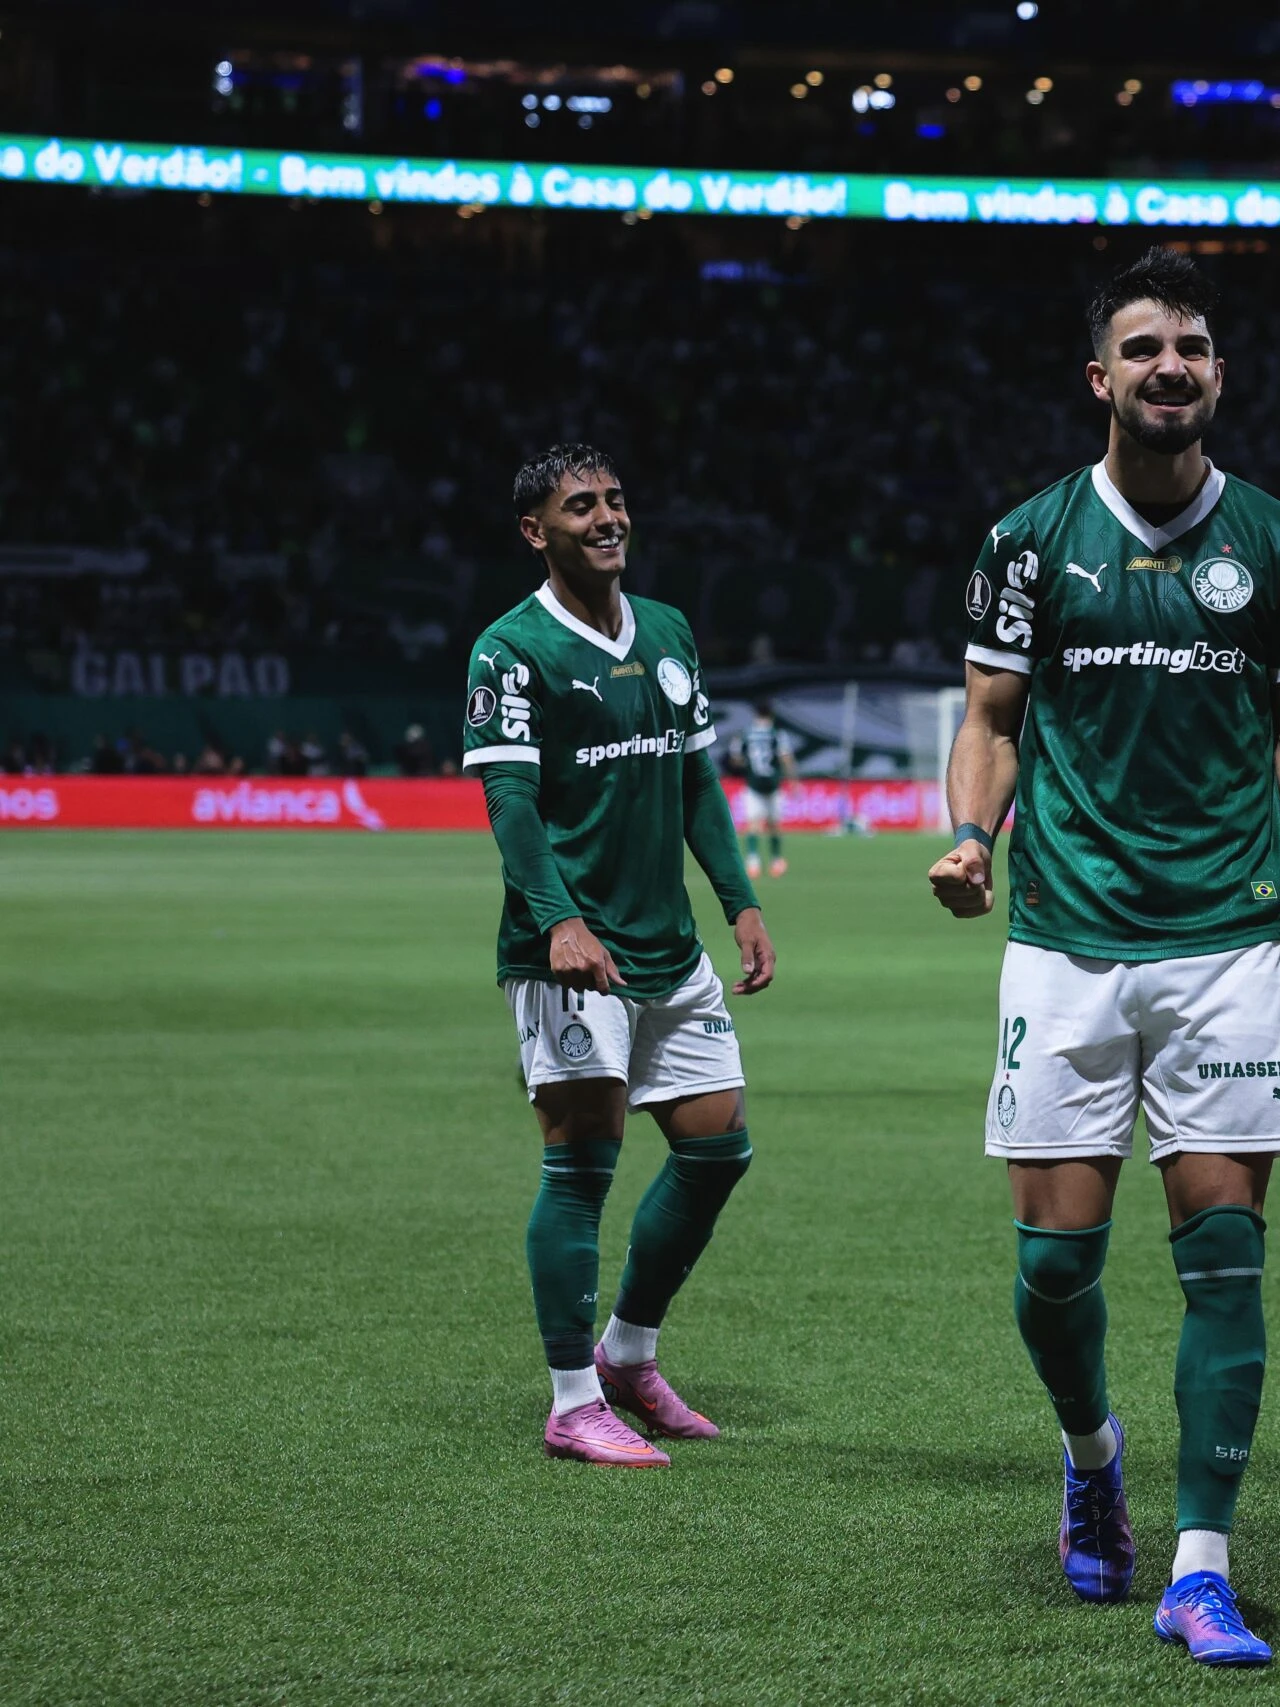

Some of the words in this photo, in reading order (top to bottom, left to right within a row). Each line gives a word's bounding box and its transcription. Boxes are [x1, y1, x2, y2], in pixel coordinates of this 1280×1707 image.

[34, 138, 85, 181] do
[279, 154, 366, 197] Bem
[374, 160, 500, 204] vindos
[542, 165, 637, 210] Casa
[643, 168, 693, 211] do
[884, 181, 968, 221] Bem
[975, 181, 1097, 224] vindos
[1135, 185, 1229, 225] Casa
[1131, 559, 1165, 570] AVANTI
[1196, 577, 1250, 609] PALMEIRAS
[1063, 641, 1246, 673] sportingbet
[192, 780, 340, 821] avianca
